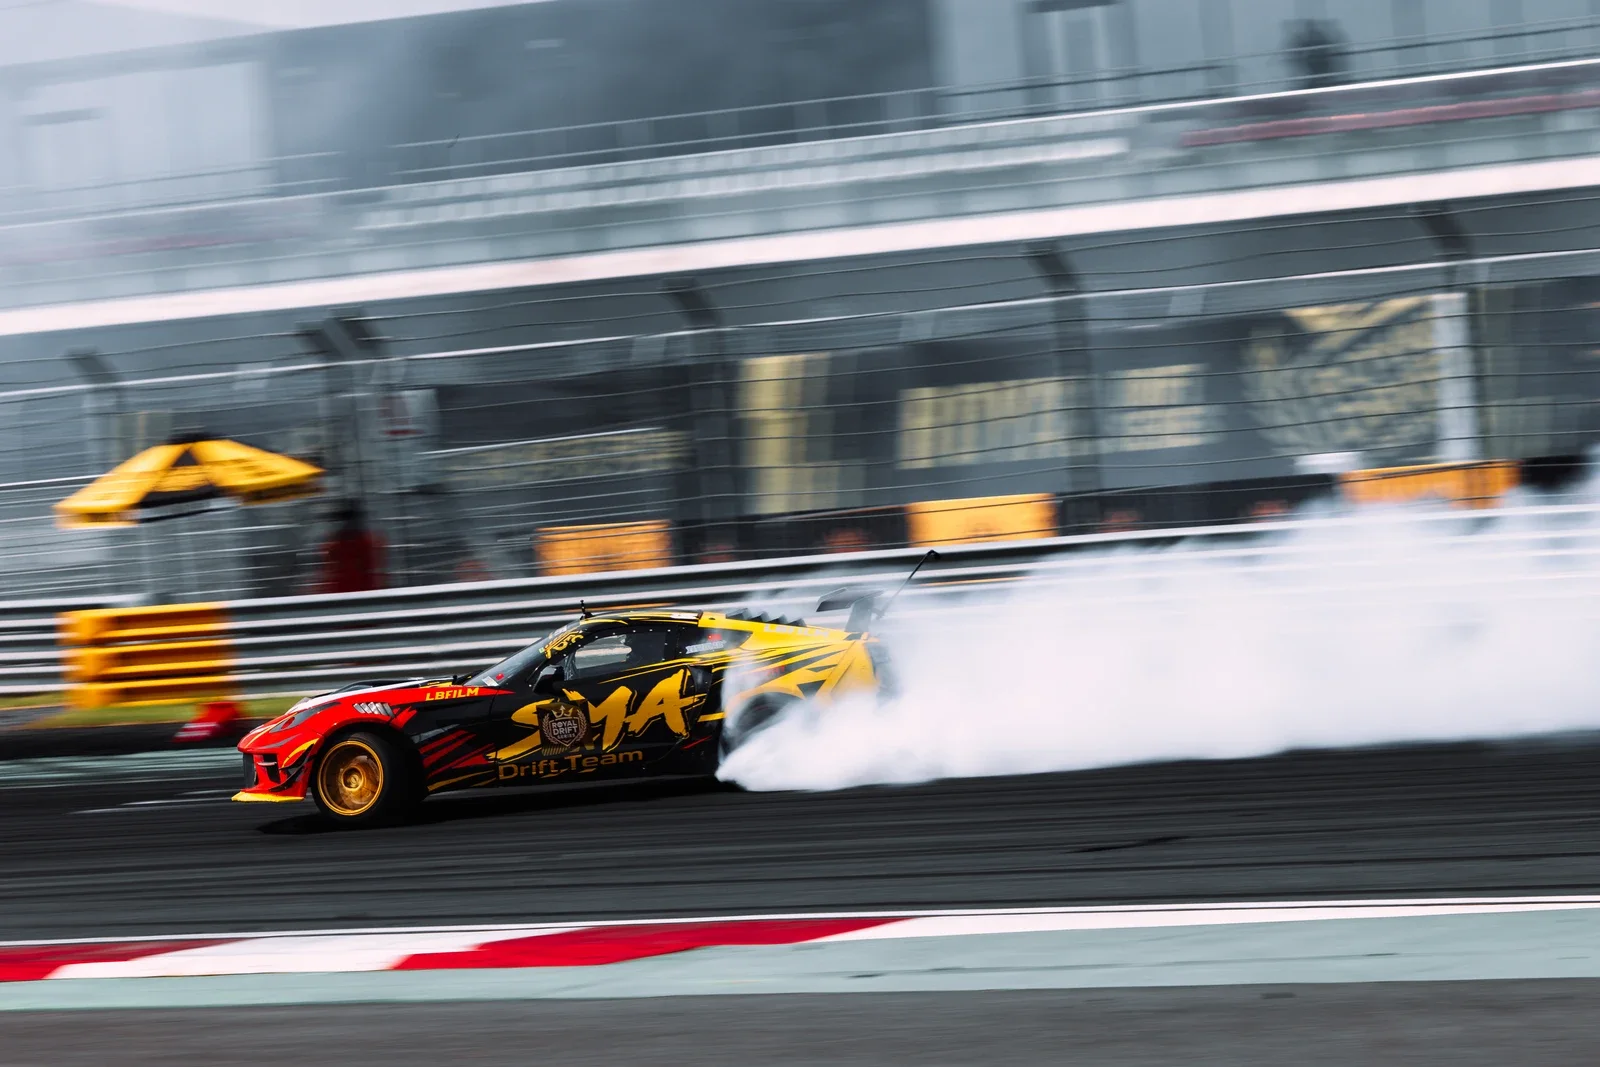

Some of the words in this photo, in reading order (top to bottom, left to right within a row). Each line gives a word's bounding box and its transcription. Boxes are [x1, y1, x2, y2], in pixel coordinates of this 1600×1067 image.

[425, 687, 480, 701] LBFILM
[551, 720, 577, 729] ROYAL
[553, 725, 578, 736] DRIFT
[499, 759, 561, 780] Drift
[565, 750, 643, 771] Team
